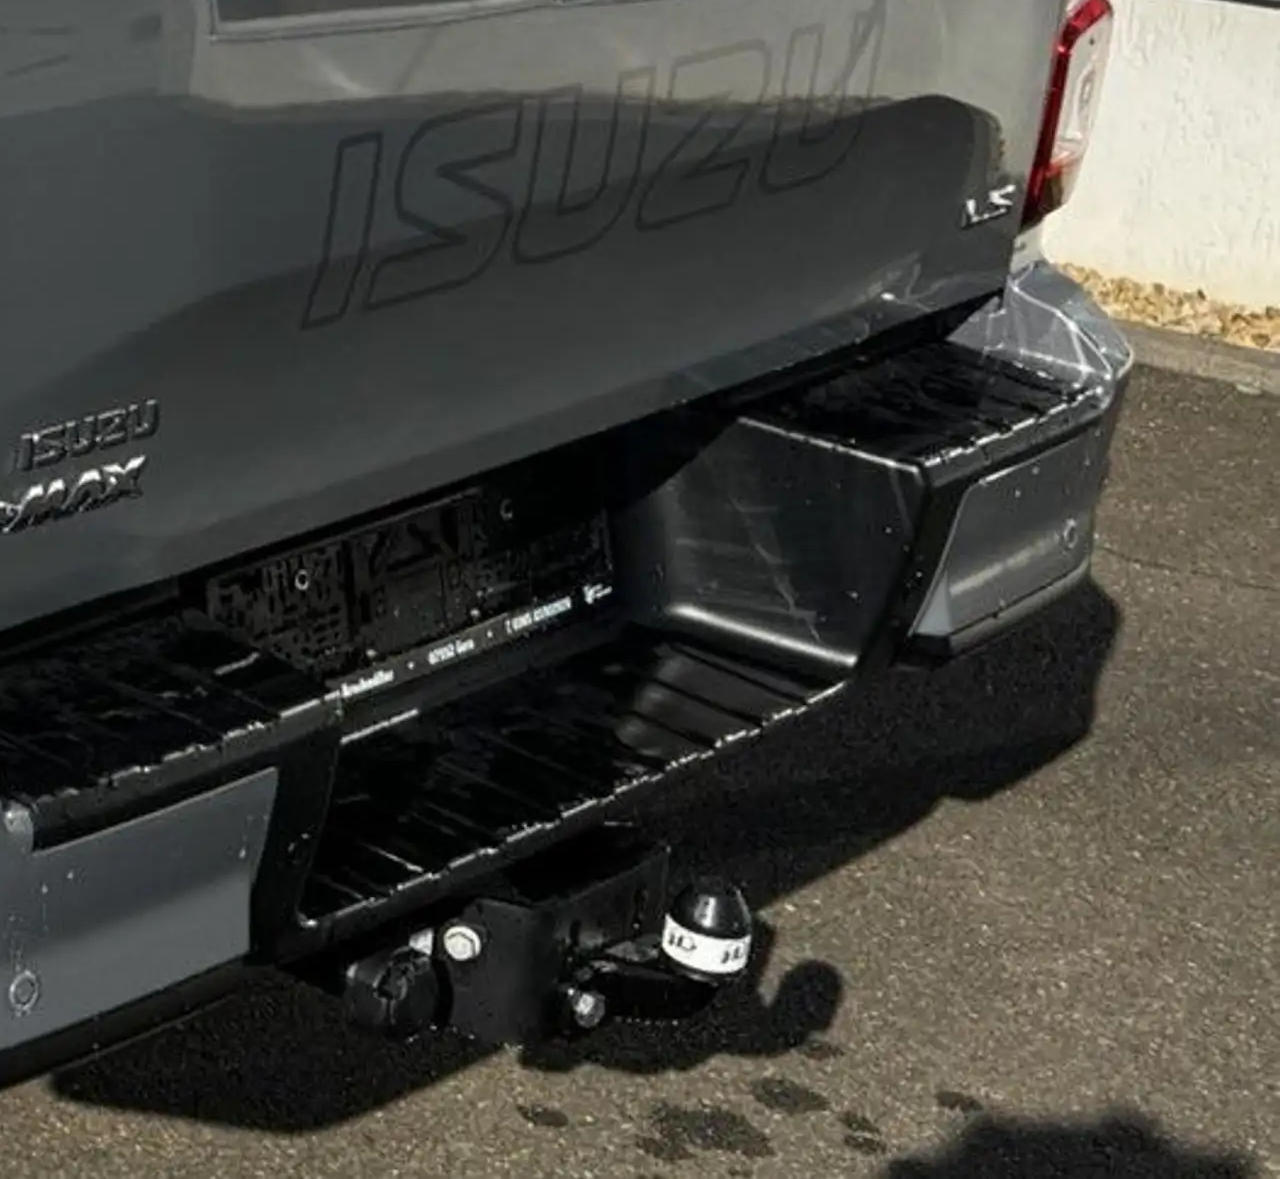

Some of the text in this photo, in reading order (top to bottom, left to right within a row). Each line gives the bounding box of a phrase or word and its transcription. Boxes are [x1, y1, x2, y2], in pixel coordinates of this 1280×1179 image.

[301, 16, 887, 331] ISUZU
[961, 183, 1017, 228] LS
[12, 398, 158, 472] ISUZU
